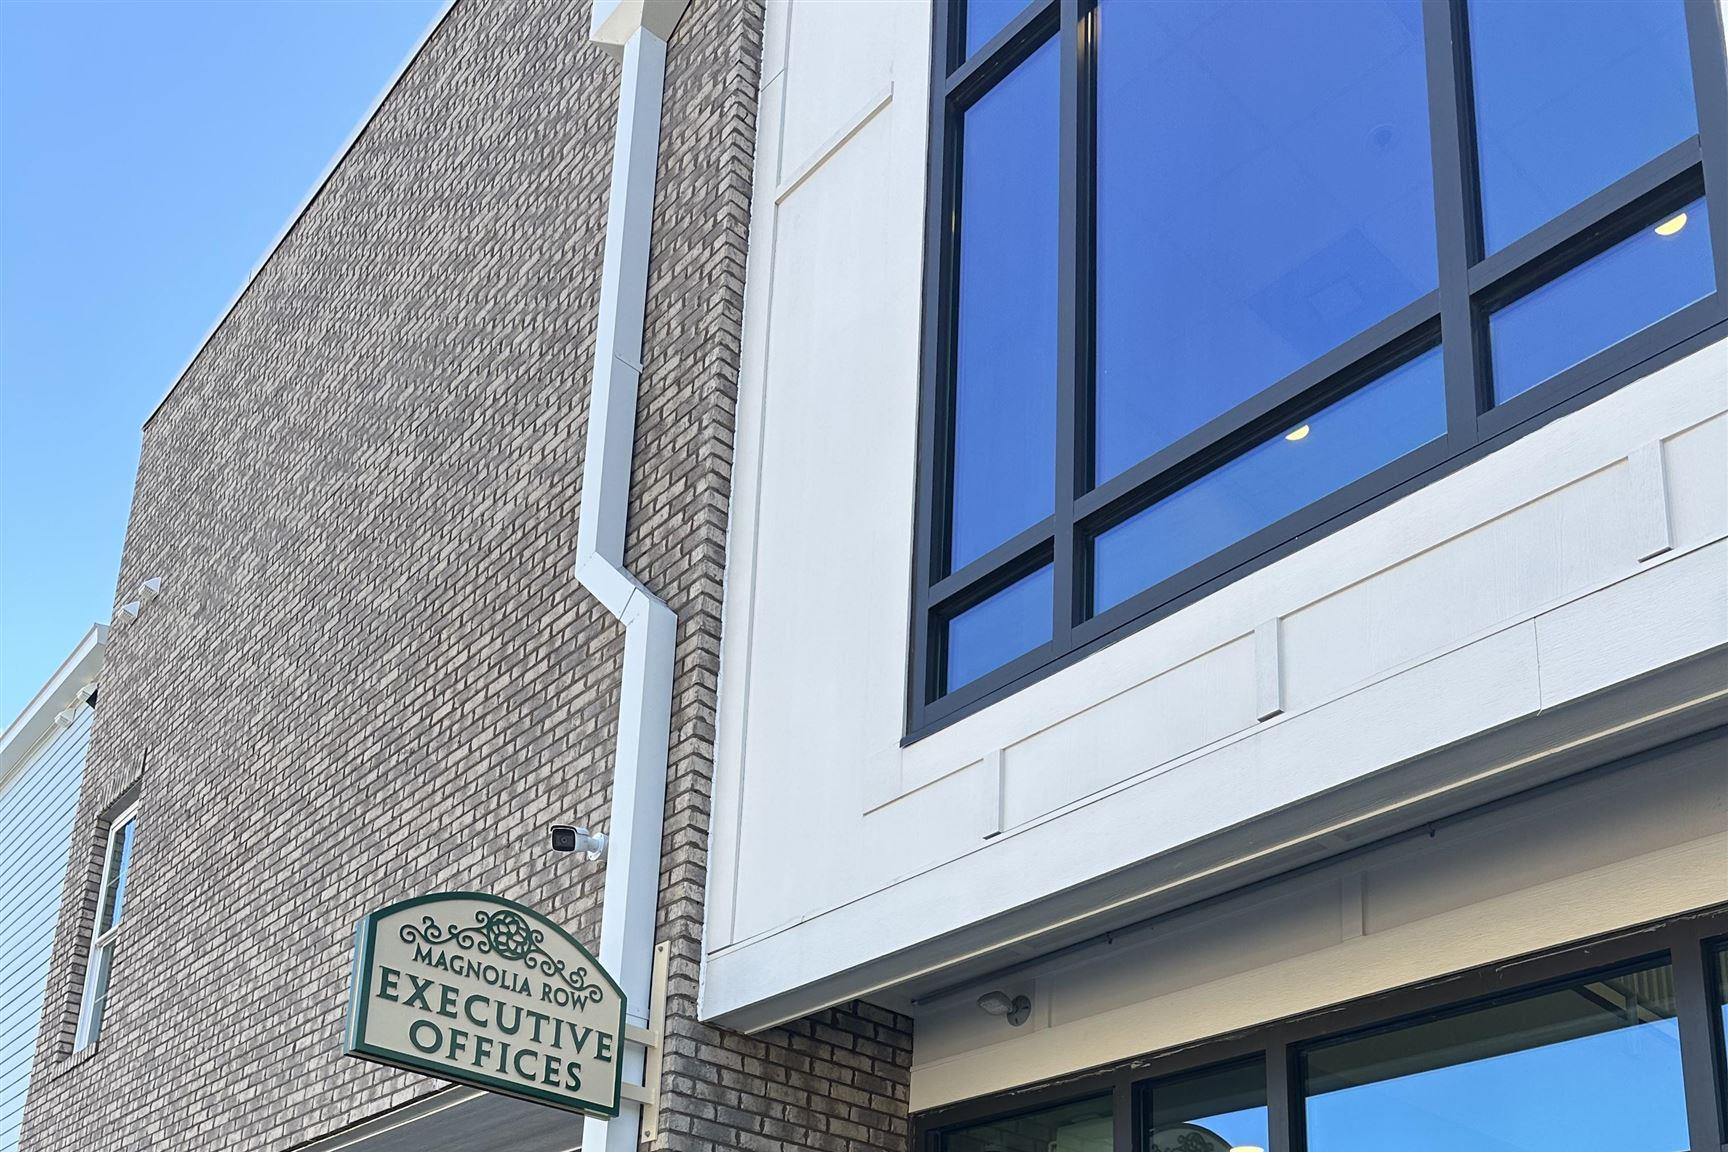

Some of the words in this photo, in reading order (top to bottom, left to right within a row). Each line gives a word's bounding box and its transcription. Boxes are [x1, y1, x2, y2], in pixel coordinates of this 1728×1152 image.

[376, 965, 613, 1063] EXECUTIVE
[412, 943, 532, 997] MAGNOLIA
[541, 982, 589, 1013] ROW
[409, 1019, 582, 1092] OFFICES
